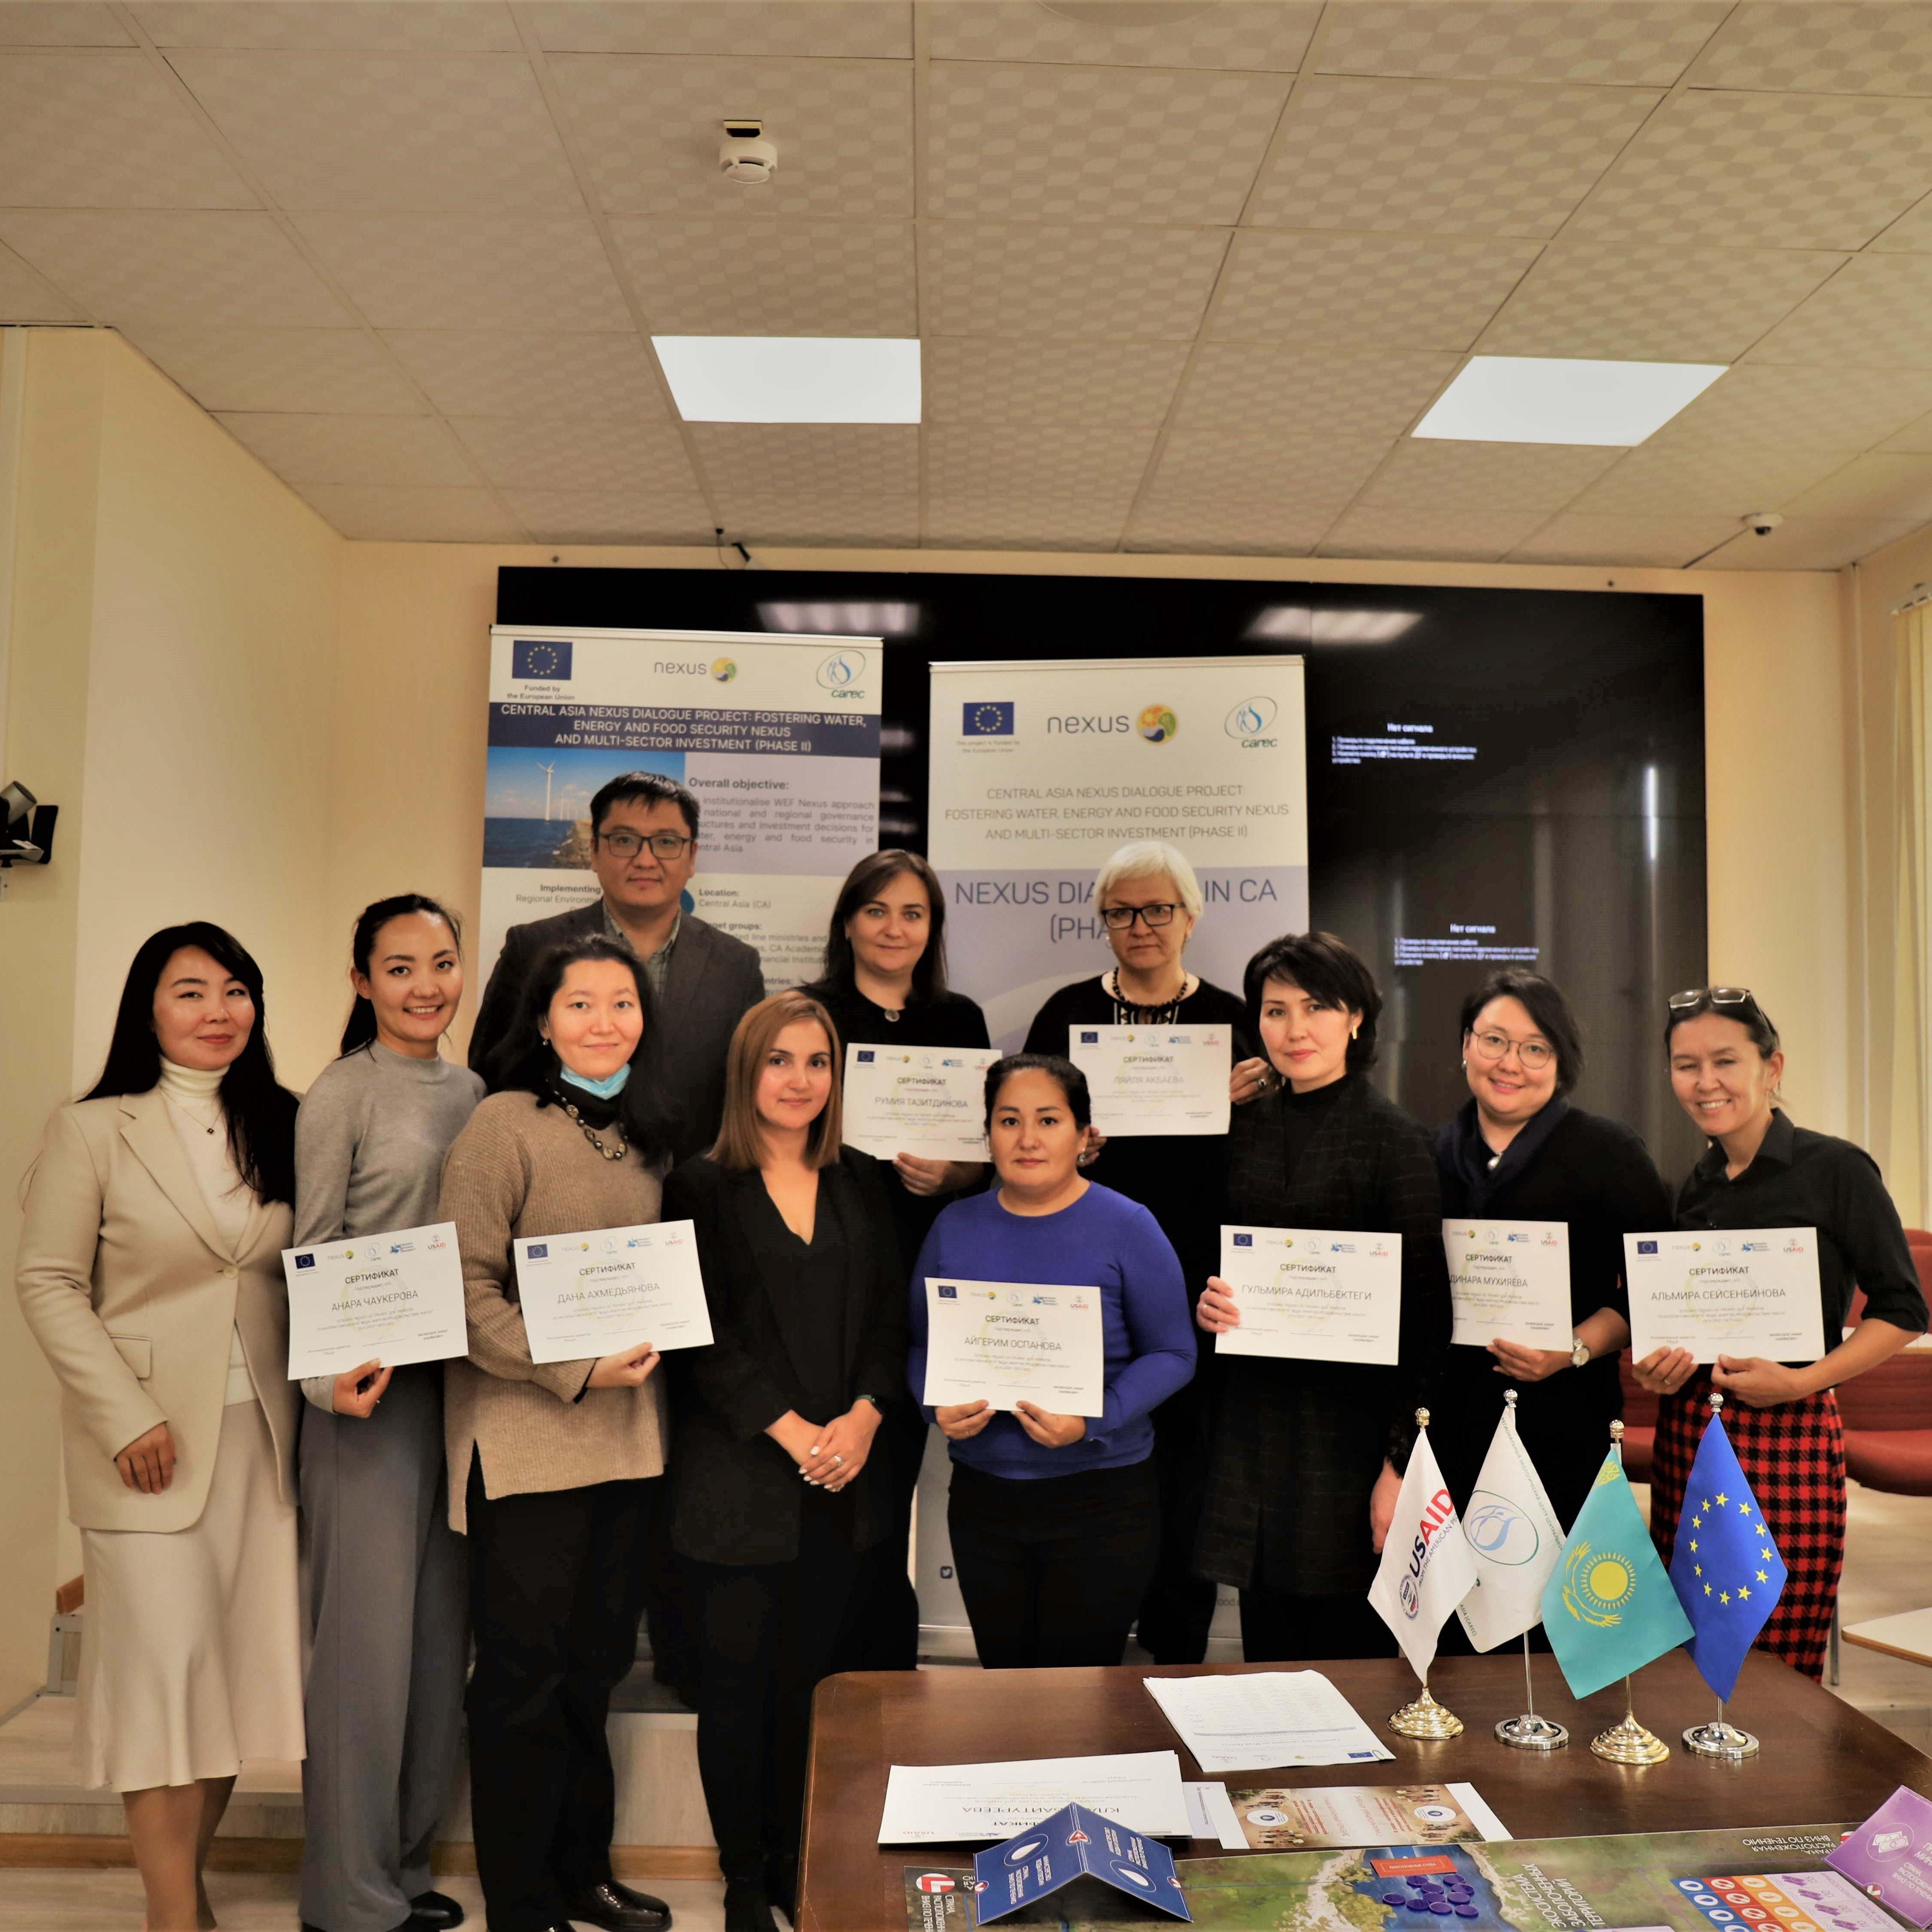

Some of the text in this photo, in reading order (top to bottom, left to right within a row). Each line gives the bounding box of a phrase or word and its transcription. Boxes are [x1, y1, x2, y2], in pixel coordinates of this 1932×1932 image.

[654, 662, 707, 675] nexus
[831, 690, 865, 699] carec
[501, 704, 867, 728] CENTRAL ASIA NEXUS DIALOGUE PROJECT: FOSTERING WATER,
[574, 721, 791, 737] ENERGY AND FOOD SECURITY NEXUS
[1048, 715, 1129, 734] nexus
[555, 734, 812, 753] AND MULTI-SECTOR INVESTMENT (PHASE II)
[1242, 738, 1277, 748] carec
[689, 778, 789, 791] Overall objective:
[987, 788, 1042, 799] CENTRAL
[1045, 788, 1073, 798] ASIA
[1076, 787, 1118, 798] NEXUS
[1122, 786, 1183, 797] DIALOGUE
[703, 797, 875, 810] institutionalise WEF Nexus approach
[704, 809, 741, 818] national
[775, 811, 812, 820] regional
[820, 813, 874, 821] governance
[945, 804, 1289, 820] FOSTERING WATER, ENERGY AND FOOD SECURITY NEXUS
[759, 821, 810, 831] investment
[814, 824, 857, 832] decisions
[862, 824, 874, 833] for
[985, 825, 1247, 840] AND MULTI-SECTOR INVESTMENT (PHASE II)
[724, 834, 756, 843] energy
[791, 834, 812, 843] food
[820, 836, 857, 845] security
[724, 844, 743, 853] Asia
[541, 884, 601, 894] Implementing
[699, 888, 740, 897] Location:
[956, 881, 1050, 905] NEXUS
[1205, 880, 1229, 902] IN
[1239, 879, 1277, 902] CA
[516, 894, 553, 903] Regional
[753, 900, 771, 909] (CA)
[897, 1077, 946, 1085] СЕРТИФИКАТ
[875, 1097, 905, 1106] РУМИЯ
[1465, 1254, 1513, 1263] СЕРТИФИКАТ
[579, 1263, 636, 1276] СЕРТИФИКАТ
[1280, 1263, 1336, 1273] СЕРТИФИКАТ
[1689, 1266, 1749, 1276] СЕРТИФИКАТ
[345, 1268, 399, 1284] СЕРТИФИКАТ
[558, 1283, 660, 1305] ДАНА АХМЕДЬЯНОВА
[1242, 1284, 1371, 1300] ГУЛЬМИРА АДИЛЬБЕКТЕГИ
[1651, 1287, 1786, 1301] АЛЬМИРА СЕЙСЕНБИНОВА
[331, 1290, 418, 1312] АНАРА ЧАУКЕРОВА
[985, 1315, 1039, 1325] СЕРТИФИКАТ
[964, 1335, 1062, 1351] АЙГЕРИМ ОСПАНОВА
[1519, 1458, 1541, 1501] ЭКОЛОГИЧЕСКИЙ
[1538, 1499, 1549, 1517] ЦЕНТР
[1409, 1489, 1454, 1578] USAID
[1430, 1523, 1453, 1555] AMERICAN
[1460, 1604, 1477, 1636] ASIA (CAREC)
[1743, 1837, 1787, 1845] ТЕЧЕНИЮ
[1752, 1842, 1836, 1852] РАСПОЛОЖЕННАЯ
[922, 1895, 931, 1907] ВНИЗ
[1512, 1873, 1567, 1928] ЭКОСИСТЕМА
[1522, 1863, 1586, 1927] ЗАБОЛОЧЕННЫХ
[1552, 1878, 1606, 1926] ТЕРРИТОРИЙ
